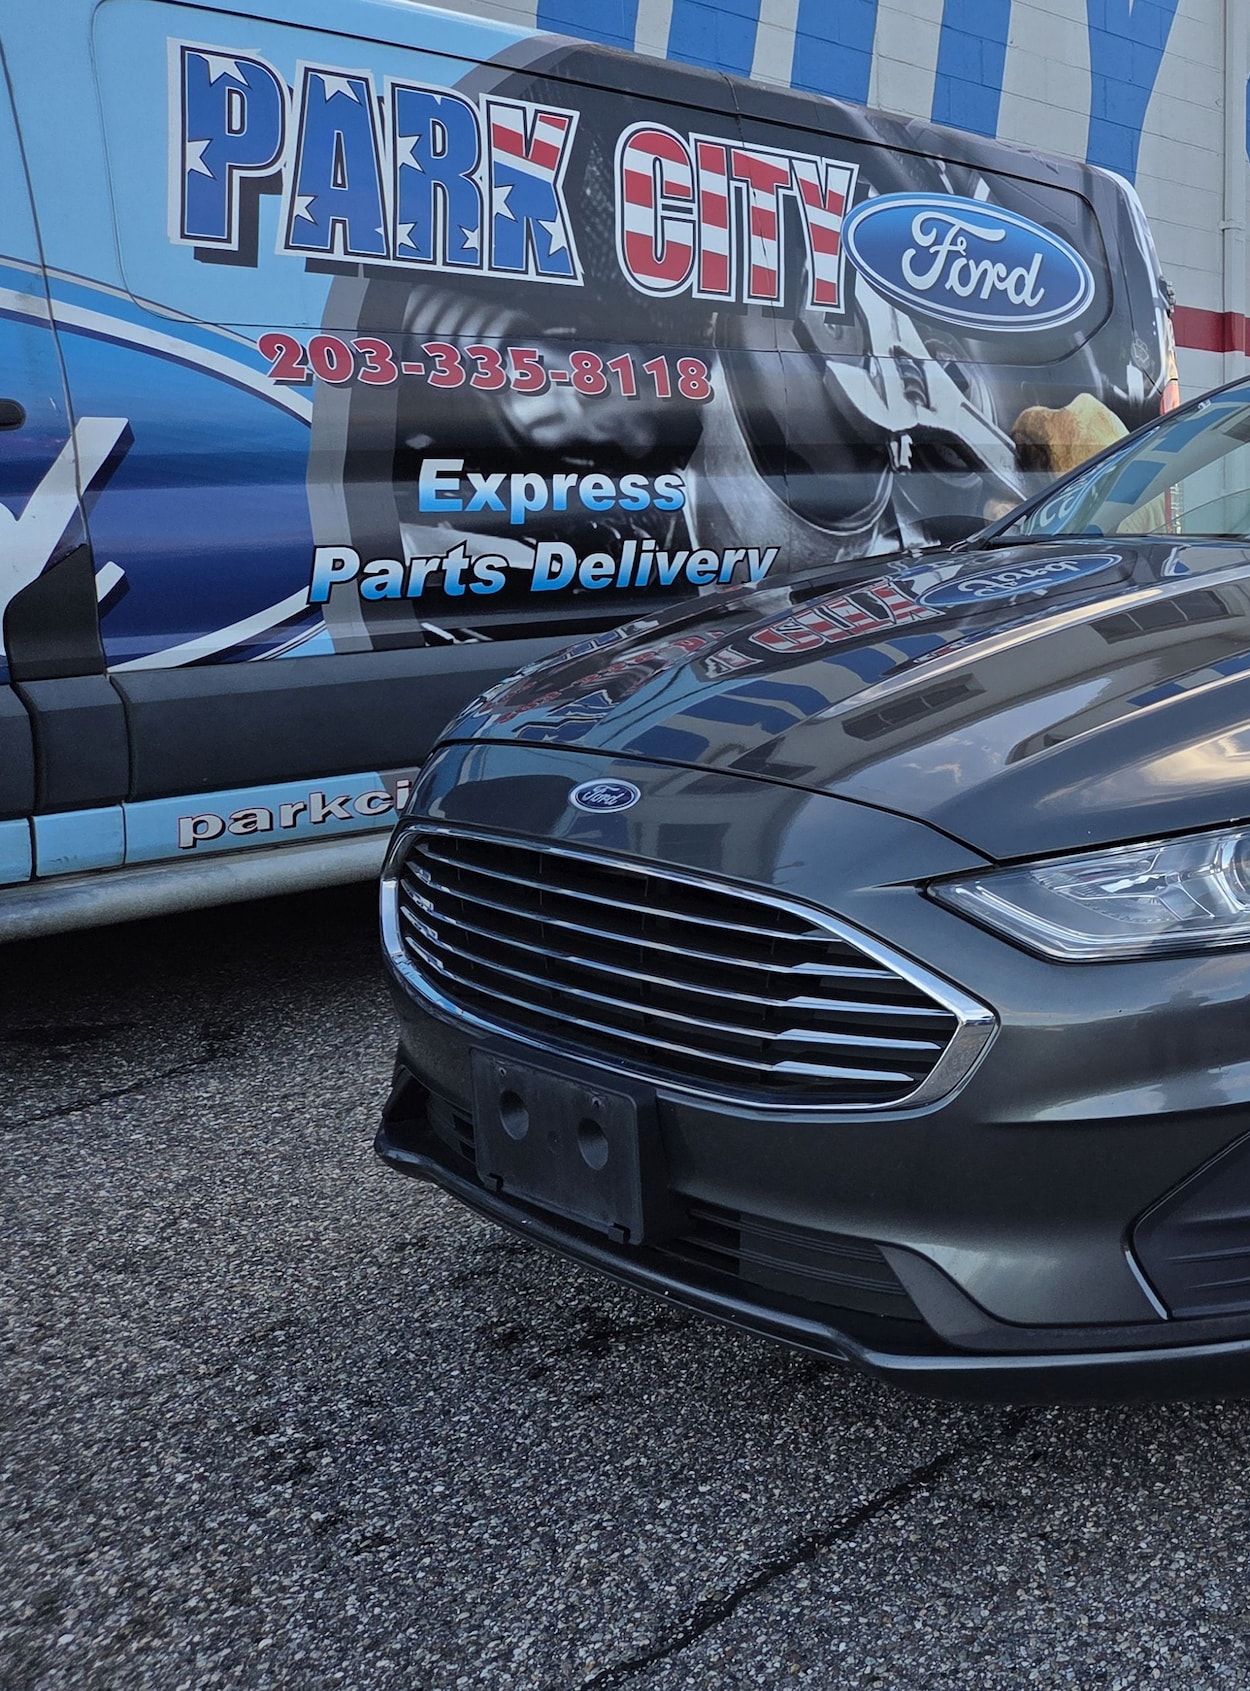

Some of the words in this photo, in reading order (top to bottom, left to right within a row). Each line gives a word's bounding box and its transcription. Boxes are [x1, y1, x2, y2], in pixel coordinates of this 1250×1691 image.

[167, 38, 584, 286] PARK
[614, 121, 859, 313] CITY
[902, 211, 1045, 307] Ford
[257, 333, 712, 400] 203-335-8118
[418, 459, 687, 525] Express
[307, 540, 509, 605] Parts
[530, 540, 780, 593] Delivery
[178, 779, 412, 849] parkci
[581, 784, 625, 806] Ford
